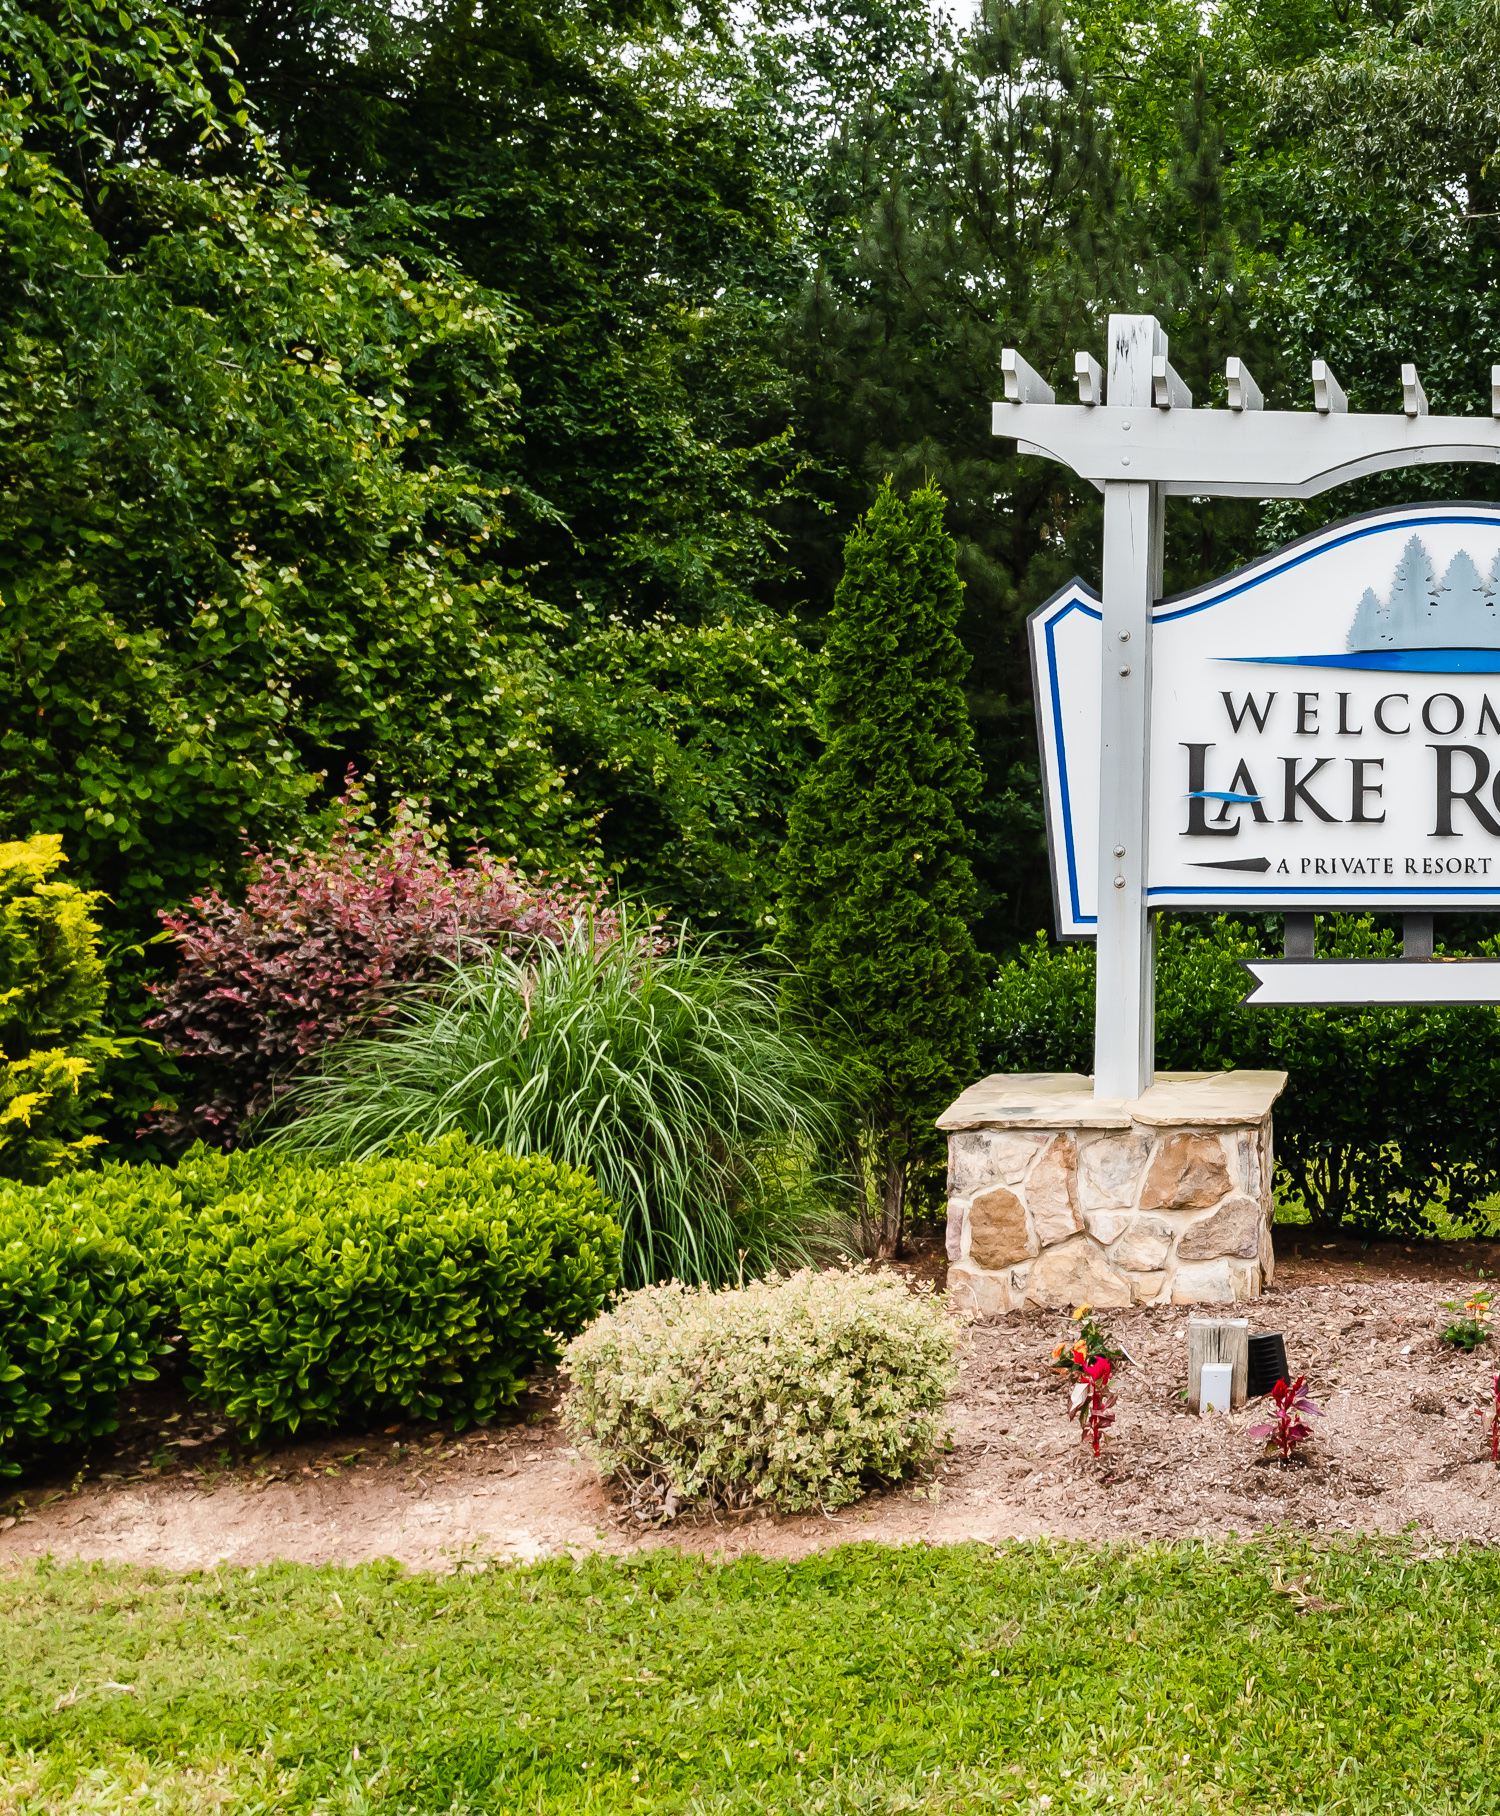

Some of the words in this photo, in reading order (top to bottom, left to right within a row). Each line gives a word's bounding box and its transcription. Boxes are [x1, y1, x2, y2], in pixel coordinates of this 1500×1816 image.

[1178, 742, 1386, 838] LAKE
[1276, 858, 1290, 874] A
[1301, 857, 1394, 875] PRIVATE
[1405, 857, 1488, 875] RESORT
